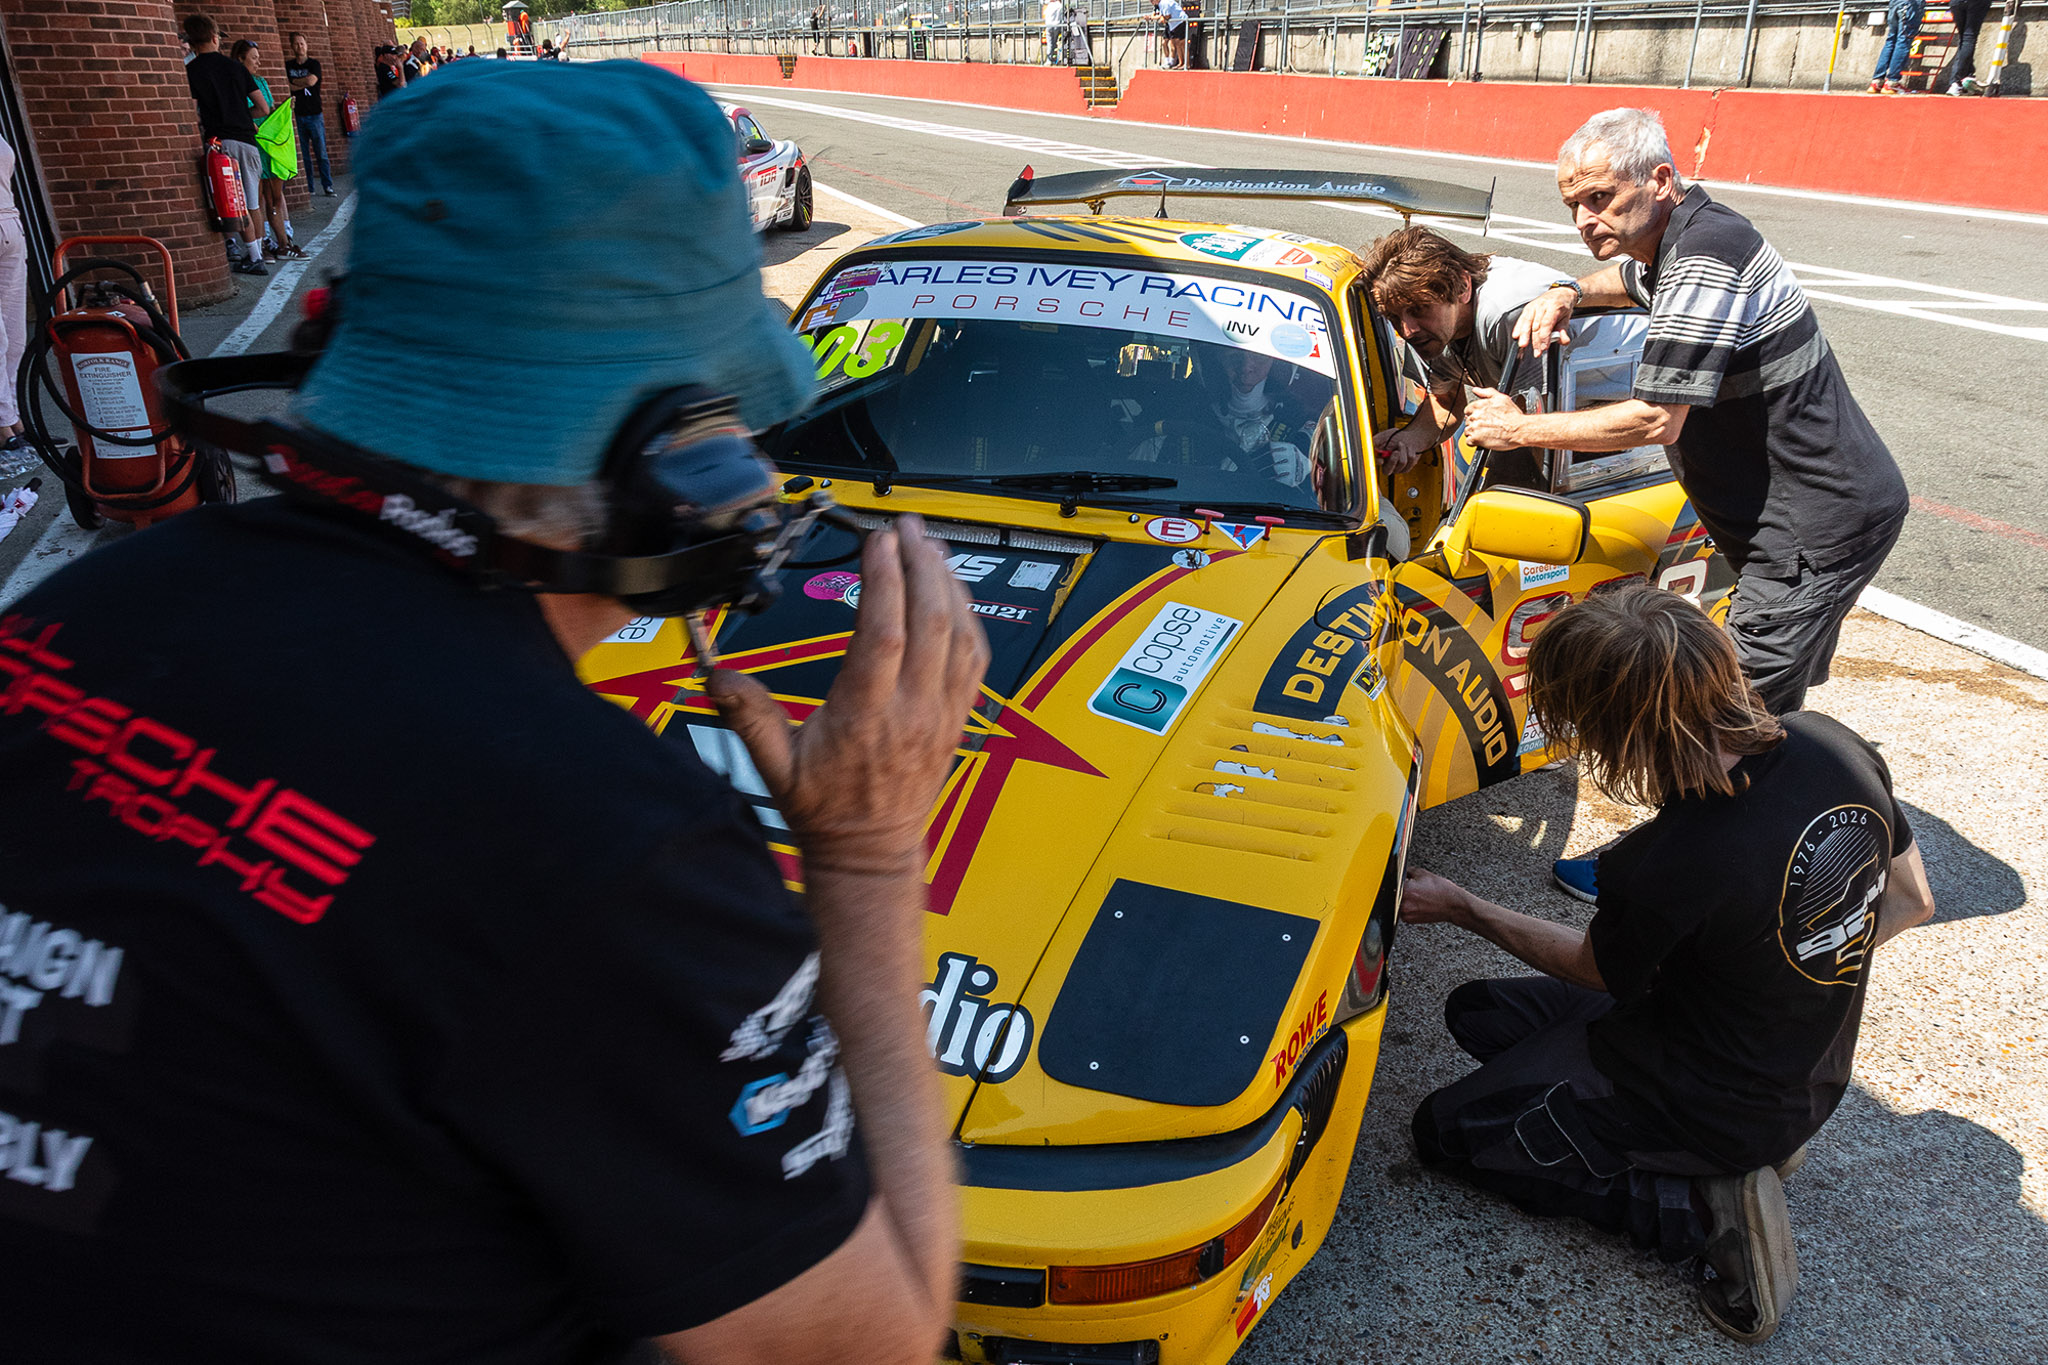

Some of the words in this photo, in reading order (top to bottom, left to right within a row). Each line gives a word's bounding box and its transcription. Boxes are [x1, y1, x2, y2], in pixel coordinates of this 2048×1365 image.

[1182, 177, 1310, 191] Destination
[1312, 180, 1386, 195] Audio
[912, 294, 1193, 328] PORSCHE
[1027, 267, 1133, 295] IVEY
[1139, 274, 1328, 333] RACING
[803, 322, 906, 380] 03
[1226, 320, 1260, 337] INV
[79, 371, 132, 379] EXTINGUISHER
[1160, 520, 1187, 538] E
[1523, 568, 1568, 585] Motorsport
[966, 602, 1028, 620] nd21
[1133, 605, 1202, 673] copse
[1173, 616, 1227, 682] automotive
[1445, 657, 1508, 767] AUDIO
[1789, 840, 1817, 887] 1976
[1829, 811, 1868, 829] 2026
[918, 956, 1026, 1074] dio
[1315, 1022, 1329, 1038] OIL
[1270, 988, 1328, 1089] ROWE
